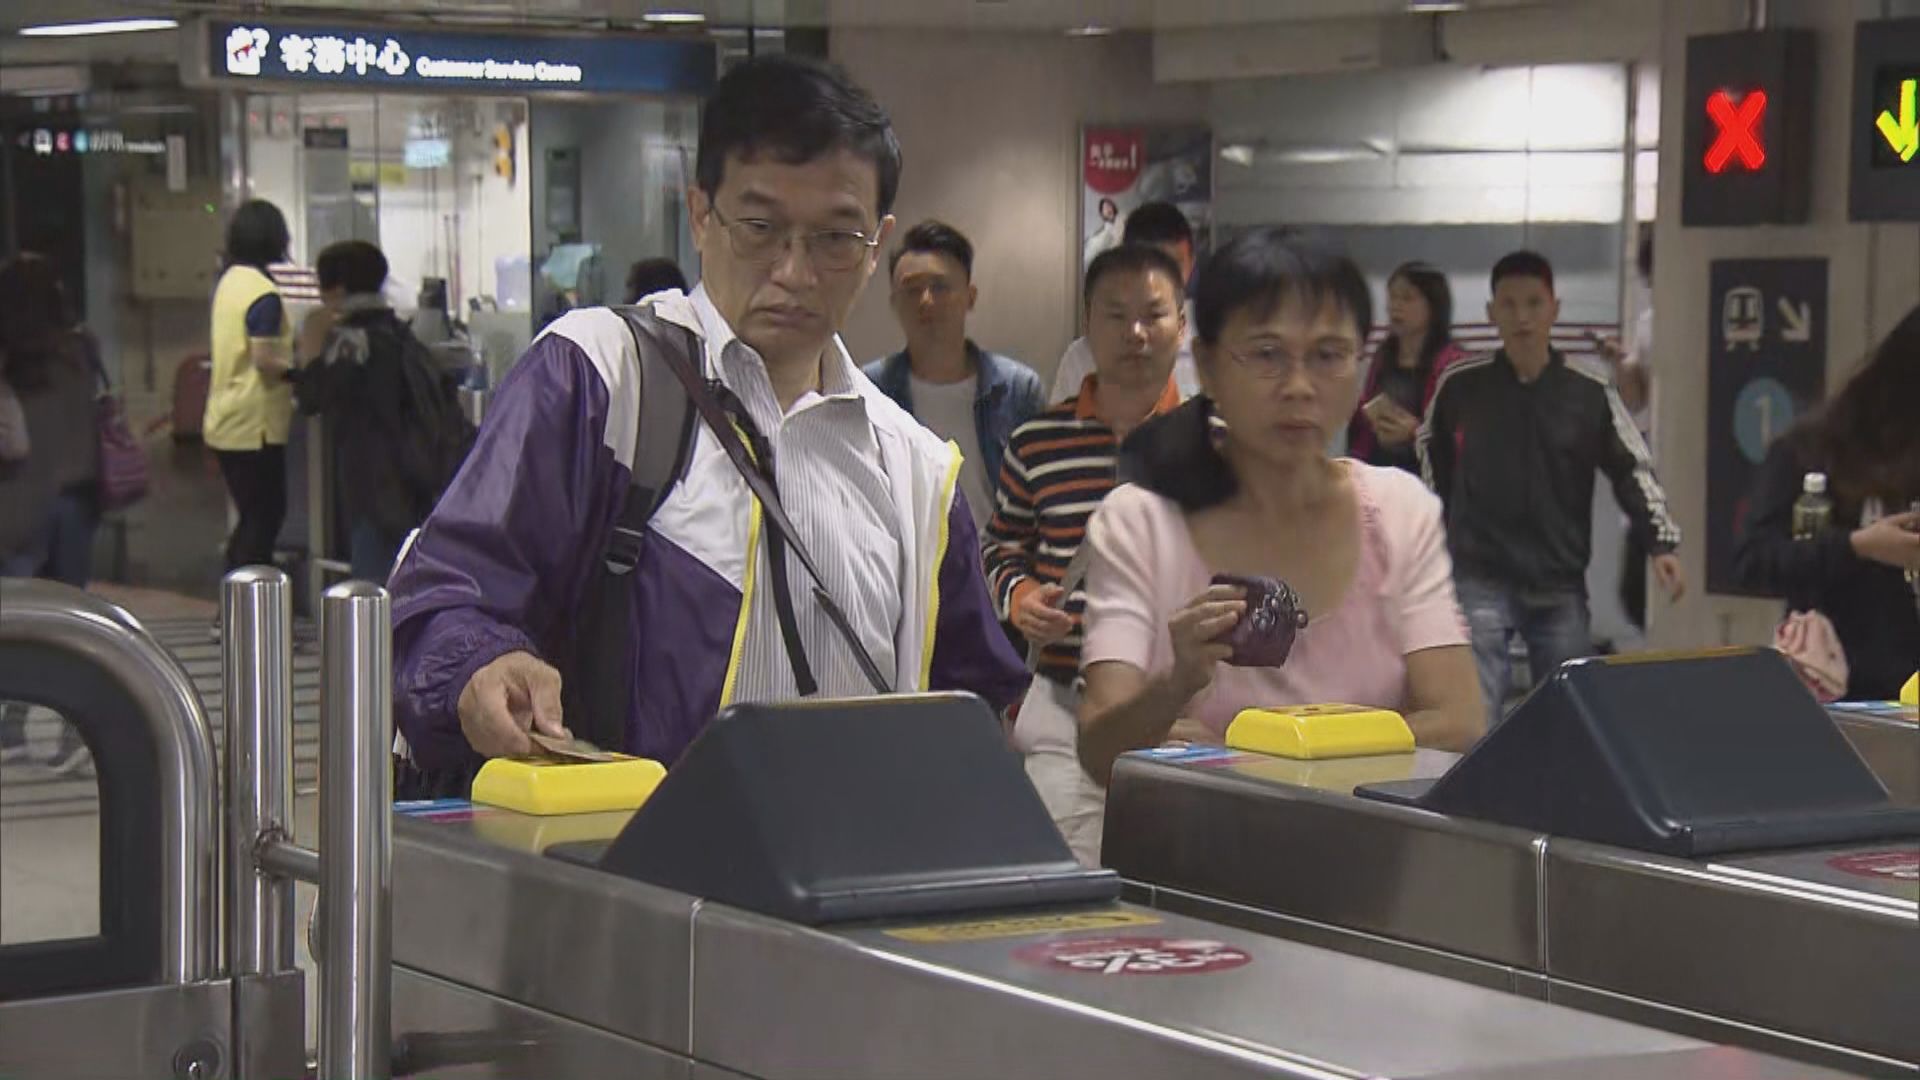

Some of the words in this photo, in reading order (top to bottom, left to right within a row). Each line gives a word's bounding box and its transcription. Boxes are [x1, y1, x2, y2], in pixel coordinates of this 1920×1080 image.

[279, 34, 410, 75] 客務中心
[416, 56, 484, 78] Customer
[484, 58, 534, 80] Service
[535, 61, 582, 82] Centre
[1754, 395, 1773, 449] 1
